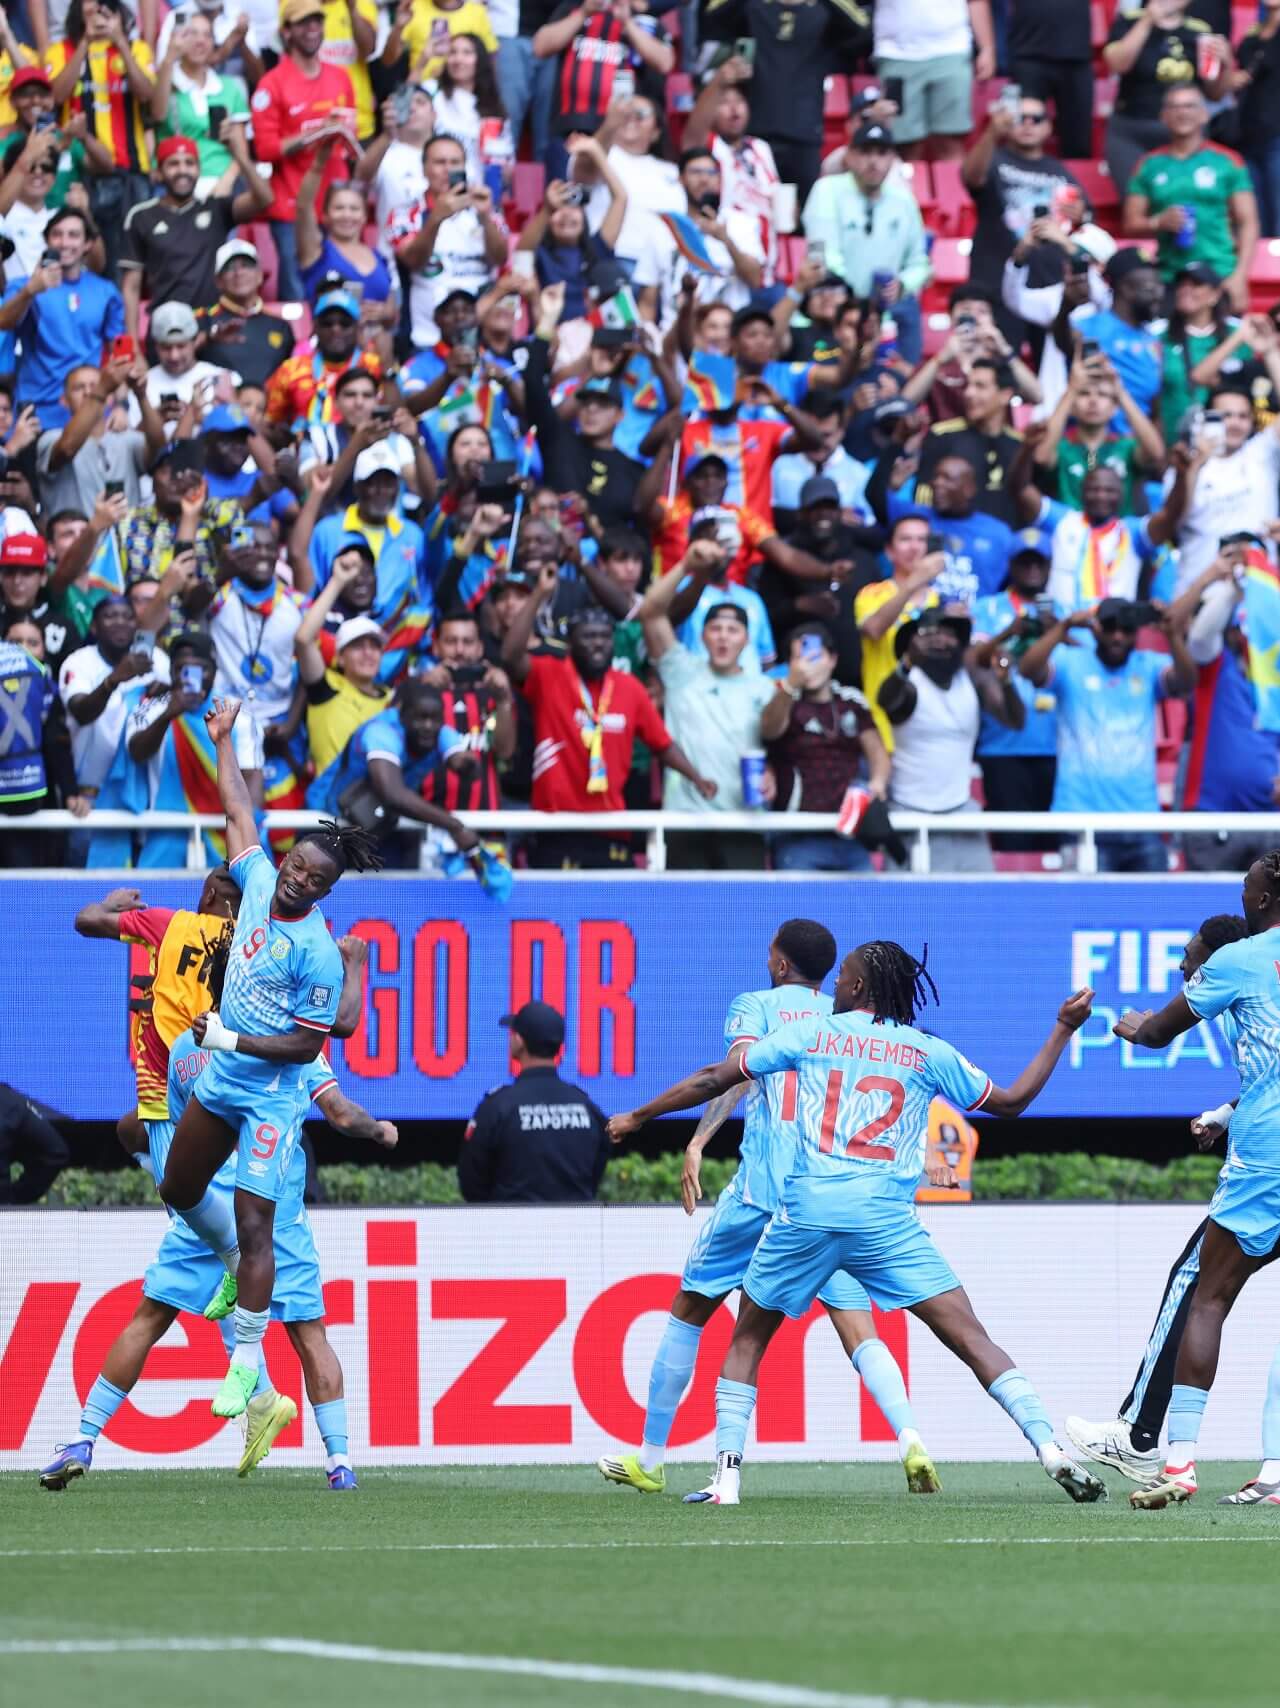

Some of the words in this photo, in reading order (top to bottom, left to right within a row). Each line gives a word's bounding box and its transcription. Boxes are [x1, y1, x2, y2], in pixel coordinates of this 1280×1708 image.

[242, 926, 267, 960] 9
[1071, 930, 1195, 994] FIF
[806, 1031, 929, 1073] J.KAYEMBE
[1070, 1003, 1224, 1069] PLA
[174, 1048, 211, 1084] BON
[780, 1070, 798, 1122] 1
[818, 1069, 906, 1161] 12
[251, 1122, 281, 1161] 9
[520, 1114, 591, 1131] ZAPOPAN
